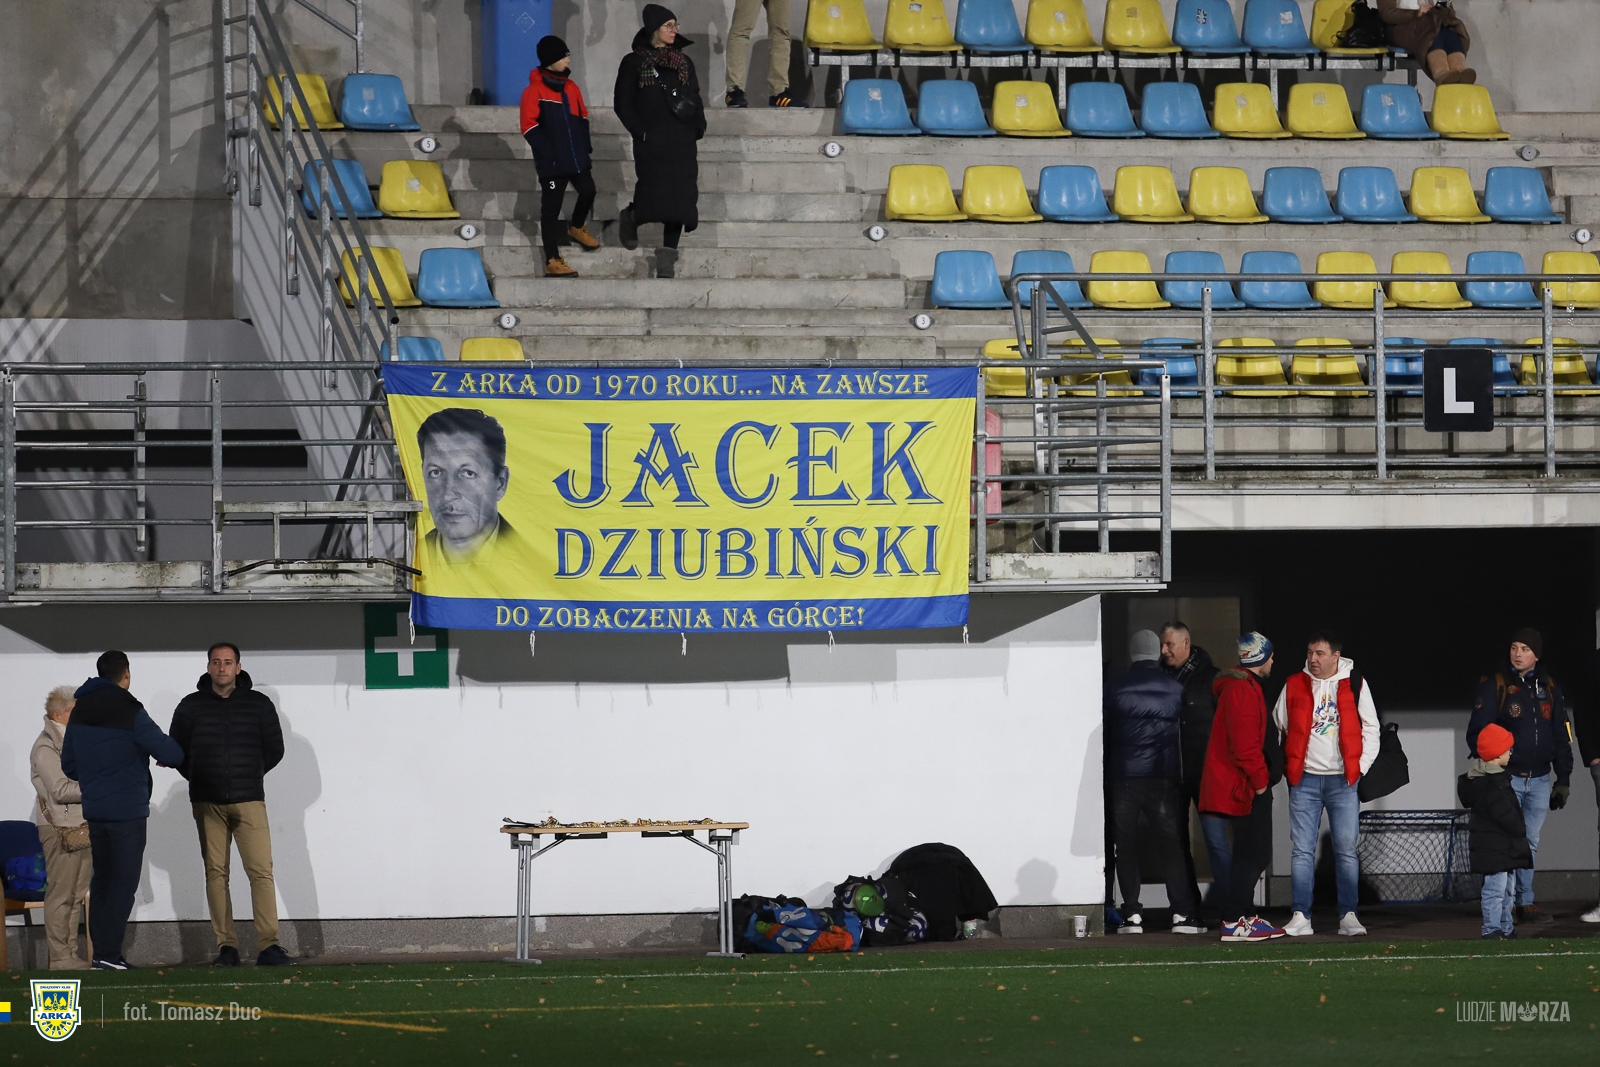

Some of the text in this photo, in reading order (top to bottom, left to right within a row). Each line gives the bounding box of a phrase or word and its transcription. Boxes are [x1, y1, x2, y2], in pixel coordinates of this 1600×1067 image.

[549, 181, 556, 190] 3
[431, 370, 930, 398] Z ARKĄ OD 1970 ROKU... NA ZAWSZE
[1443, 367, 1475, 414] L
[551, 420, 944, 509] JACEK
[553, 516, 942, 580] DZIUBIŃSKI
[495, 601, 866, 629] DO ZOBACZENIA NA GÓRCE!
